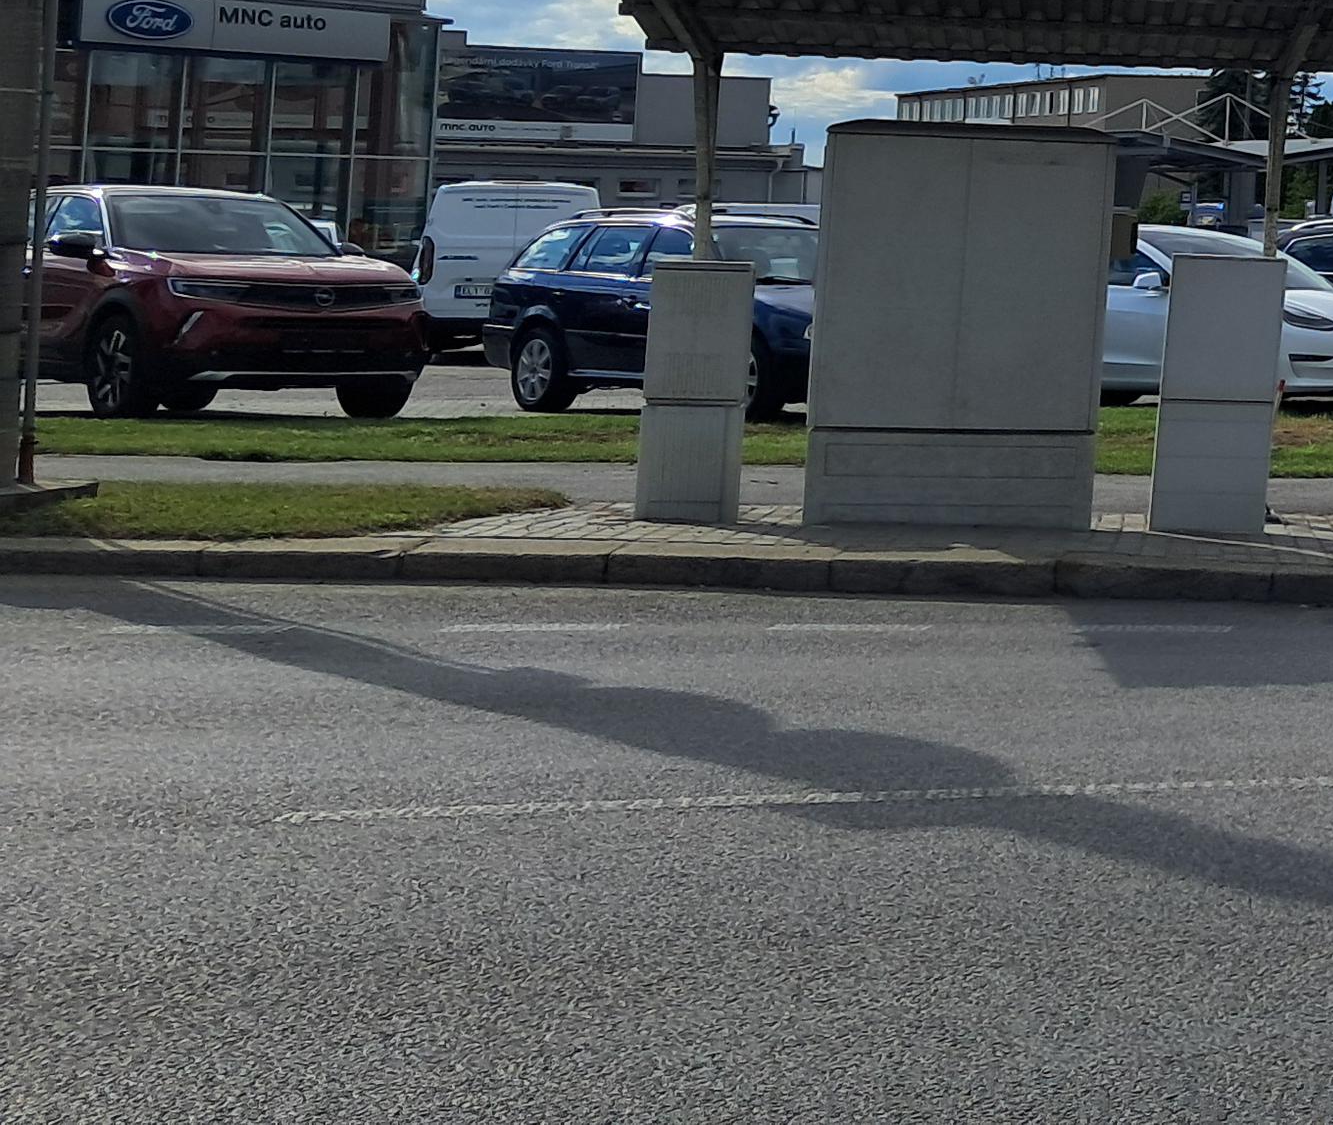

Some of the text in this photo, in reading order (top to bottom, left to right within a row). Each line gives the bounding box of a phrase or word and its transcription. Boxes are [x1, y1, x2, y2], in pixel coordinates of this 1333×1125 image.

[126, 4, 327, 31] Ford MNC auto
